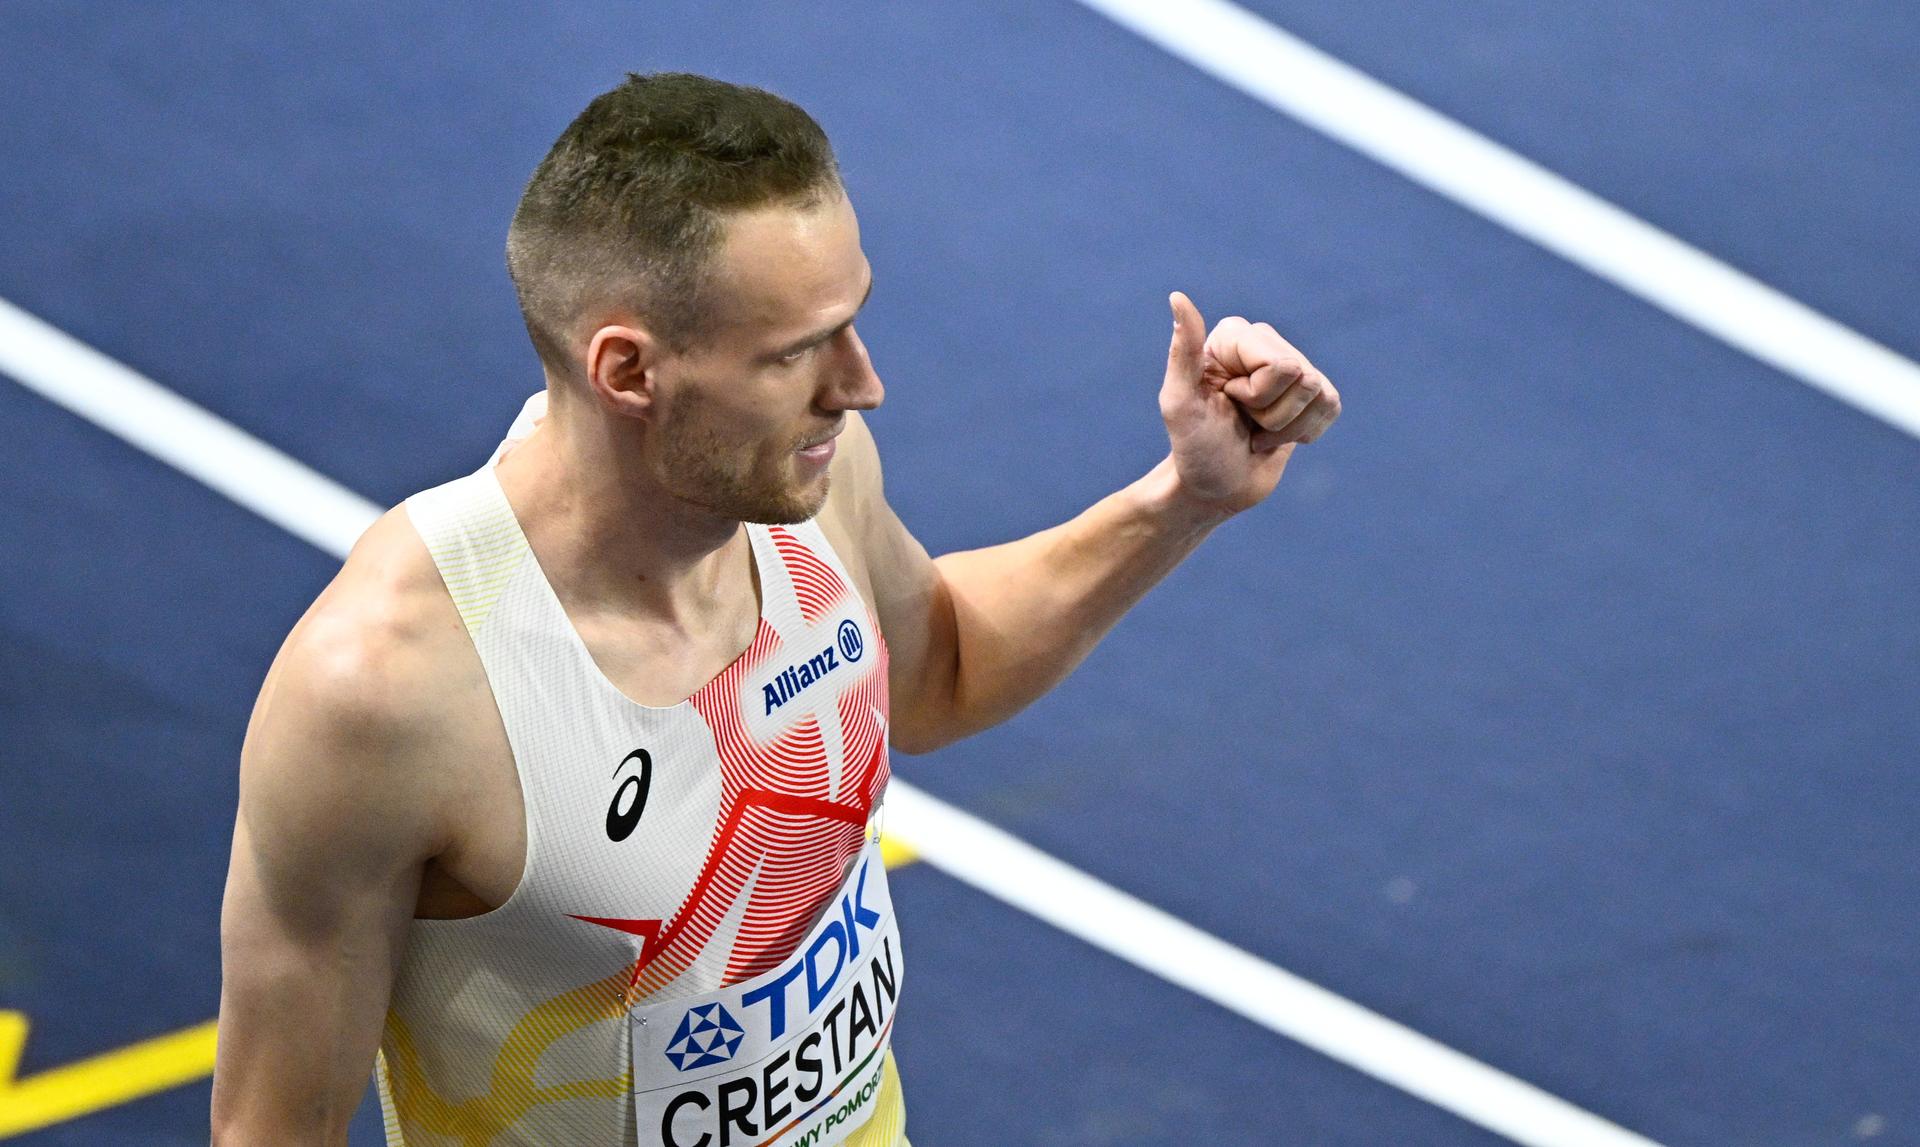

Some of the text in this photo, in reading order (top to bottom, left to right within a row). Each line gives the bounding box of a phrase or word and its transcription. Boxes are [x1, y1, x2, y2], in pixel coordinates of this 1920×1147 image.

[762, 645, 839, 716] Allianz
[742, 856, 880, 1042] TDK
[661, 936, 897, 1147] CRESTAN
[789, 1123, 822, 1147] WY
